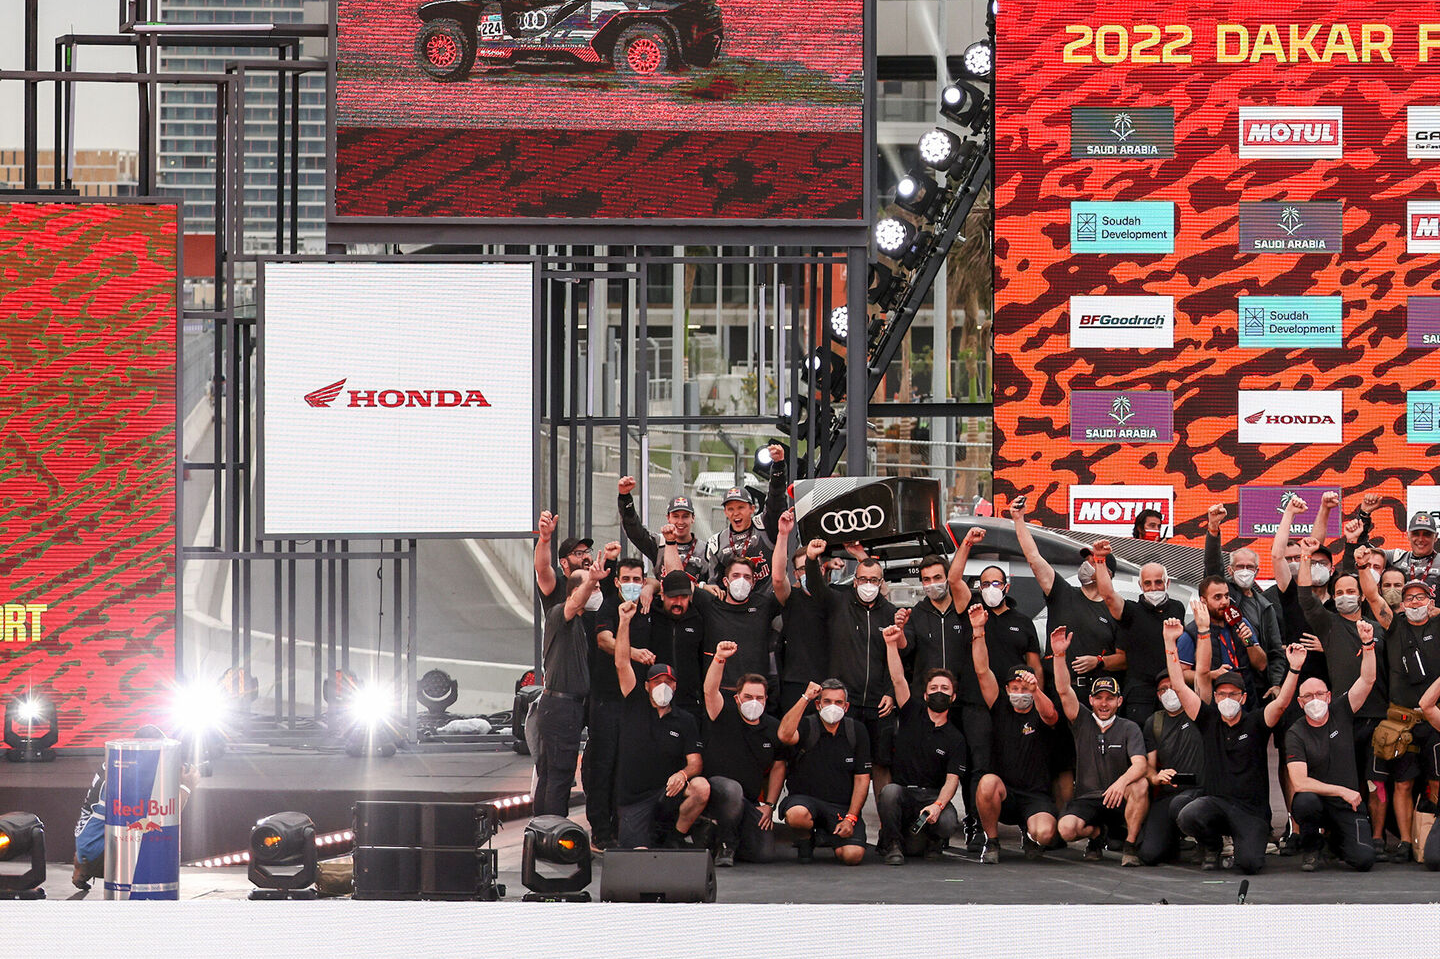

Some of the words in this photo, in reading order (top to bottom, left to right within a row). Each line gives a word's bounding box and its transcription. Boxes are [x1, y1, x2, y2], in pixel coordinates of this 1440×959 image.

[482, 22, 501, 35] 224
[1063, 24, 1194, 63] 2022
[1216, 23, 1394, 63] DAKAR
[1247, 122, 1335, 143] MOTUL
[1086, 144, 1118, 155] SAUDI
[1119, 144, 1159, 155] ARABIA
[1102, 216, 1141, 226] Soudah
[1101, 229, 1168, 241] Development
[1254, 239, 1285, 249] SAUDI
[1287, 239, 1327, 249] ARABIA
[1079, 314, 1165, 325] BFGoodrich
[1269, 310, 1309, 321] Soudah
[1269, 323, 1336, 335] Development
[347, 389, 492, 408] HONDA
[1265, 414, 1336, 425] HONDA
[1085, 428, 1117, 439] SAUDI
[1118, 428, 1158, 439] ARABIA
[1253, 523, 1280, 533] SAU
[113, 799, 145, 817] Red
[147, 798, 176, 816] Bull
